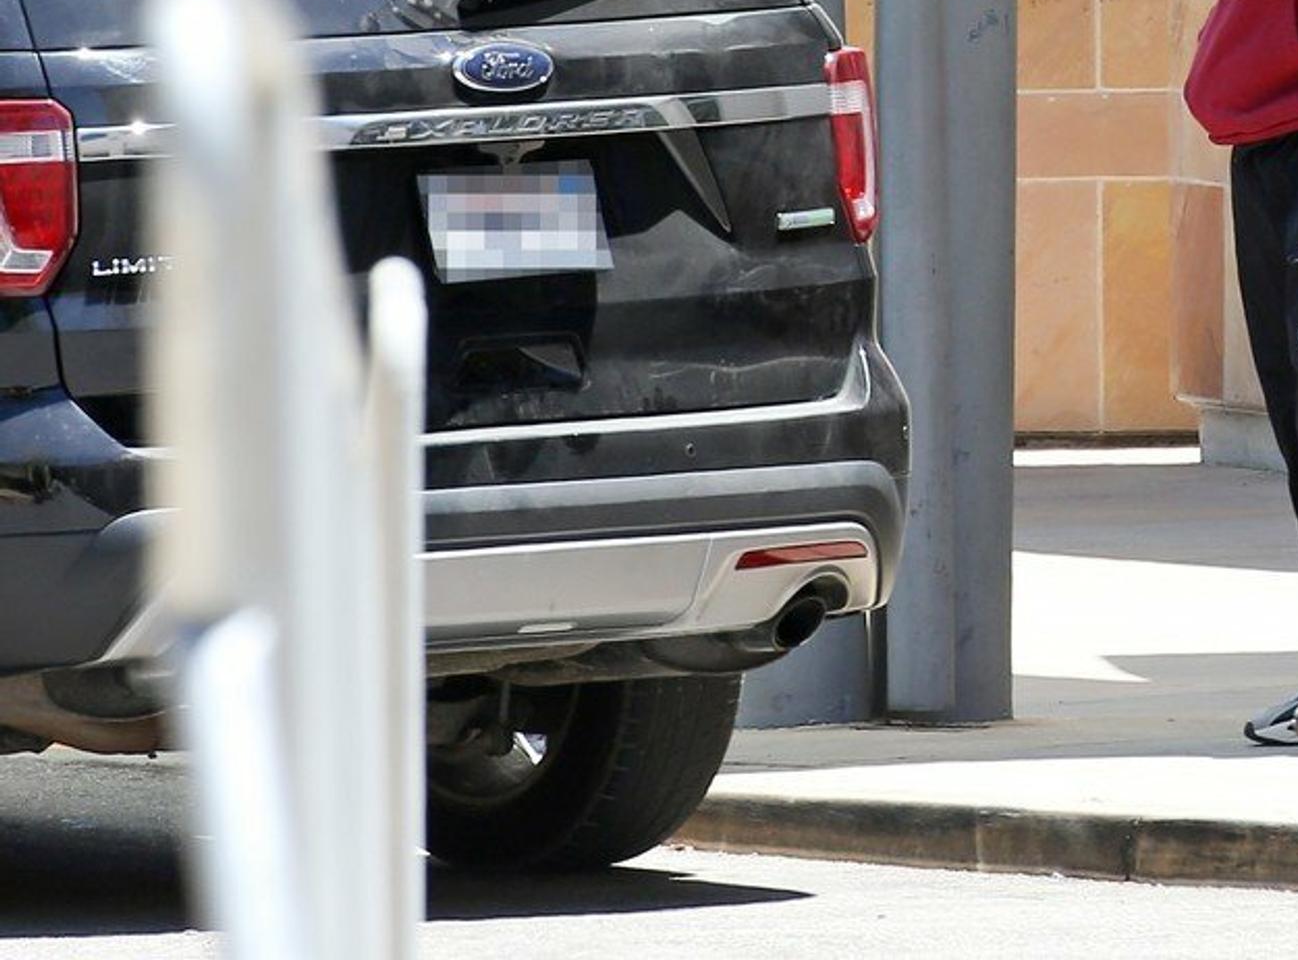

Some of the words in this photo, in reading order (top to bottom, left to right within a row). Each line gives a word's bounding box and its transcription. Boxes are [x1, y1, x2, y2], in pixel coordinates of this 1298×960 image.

[482, 50, 534, 81] Ford
[374, 108, 645, 143] EXPLORER
[91, 256, 177, 277] LIMIT
